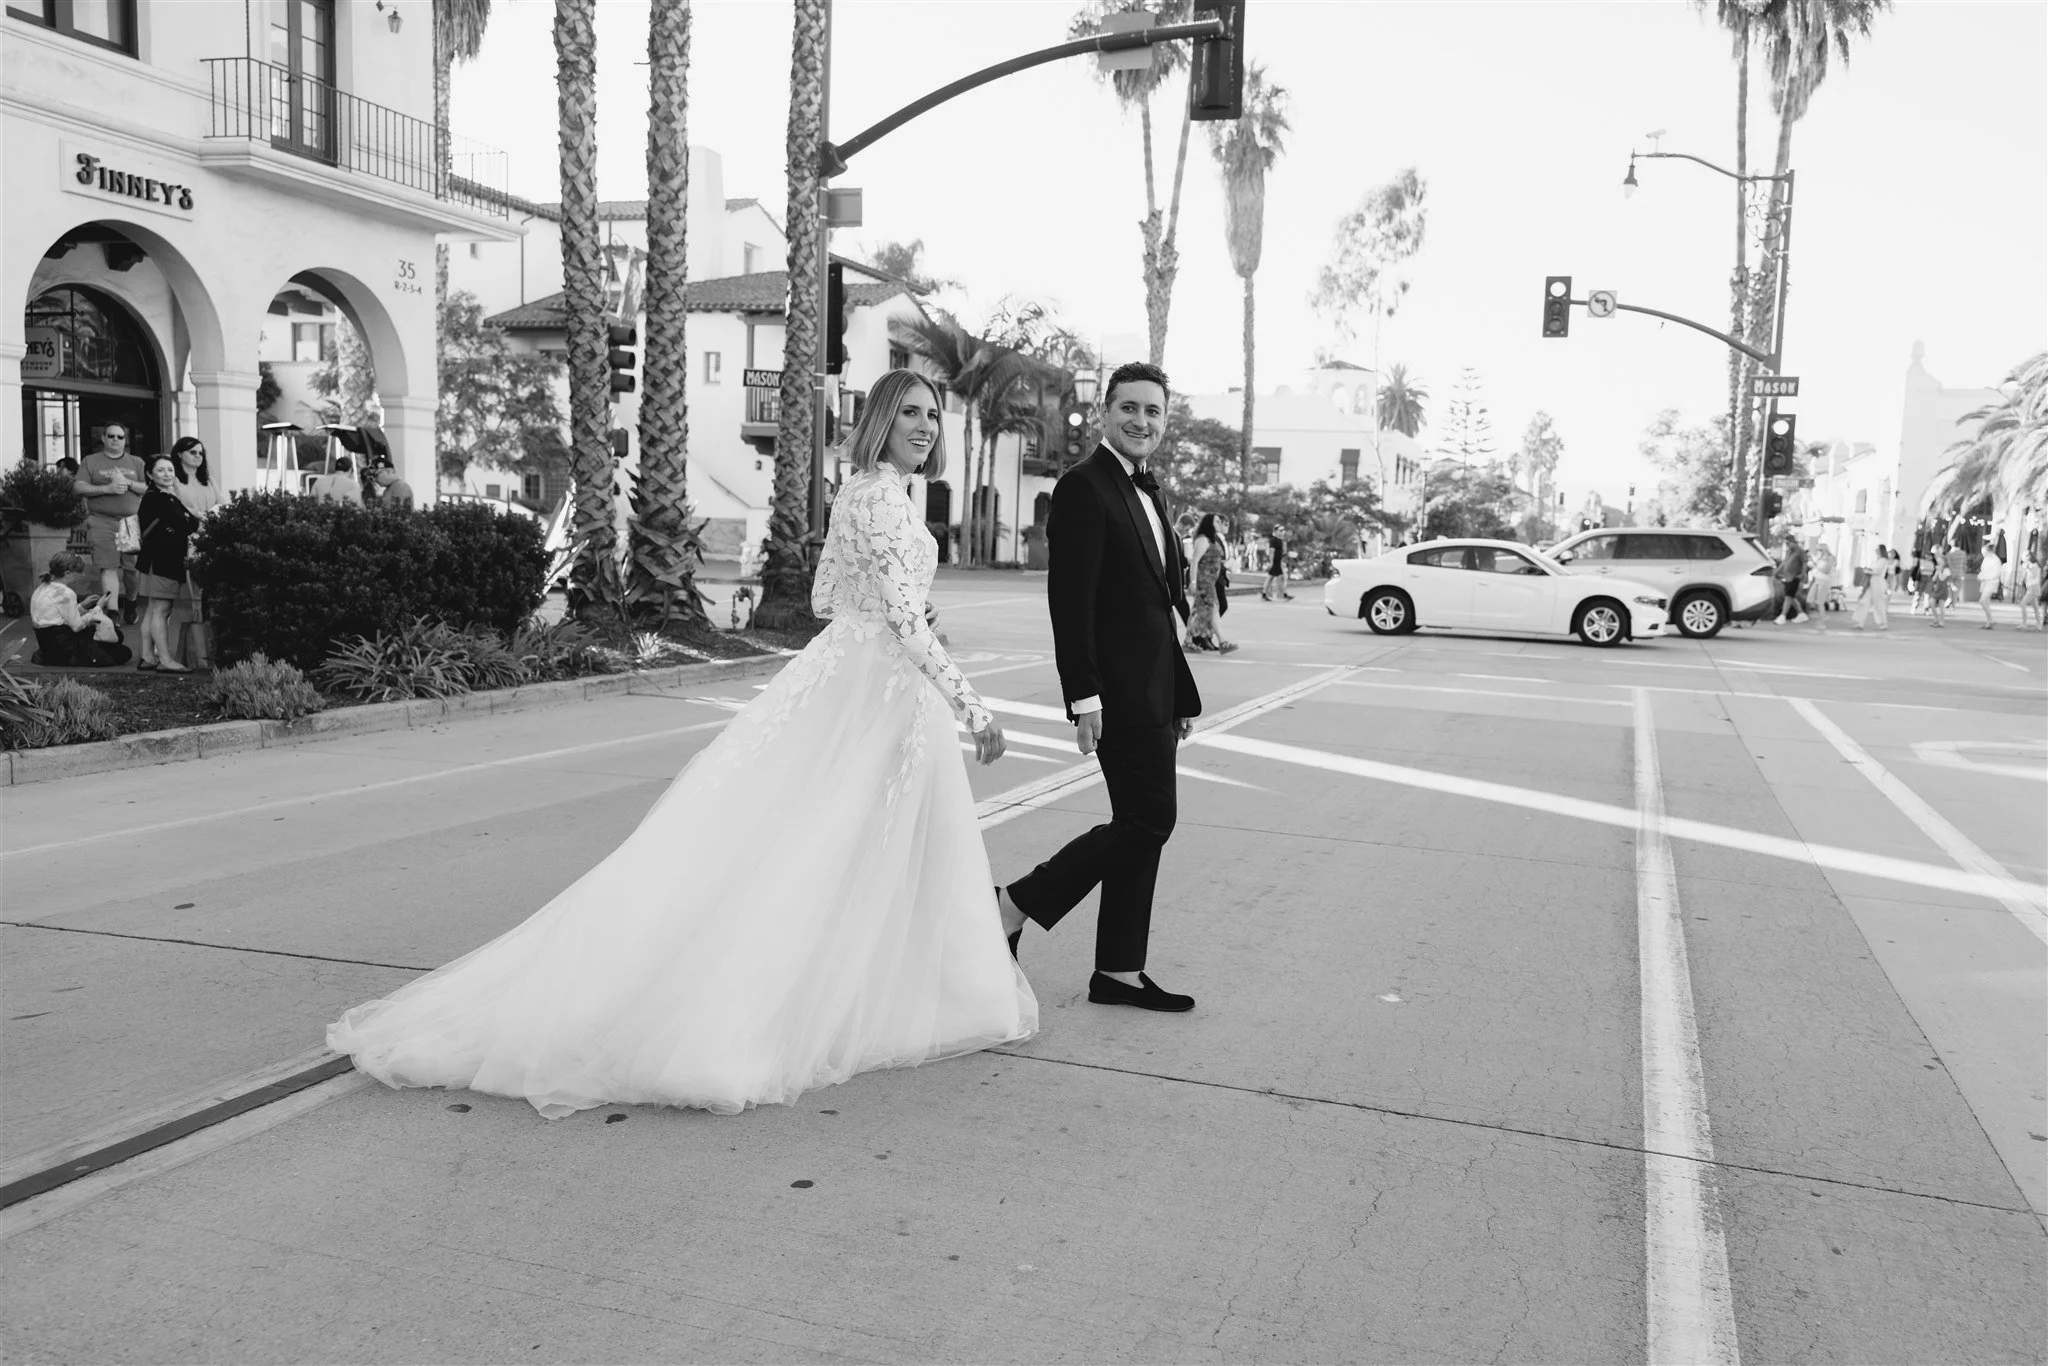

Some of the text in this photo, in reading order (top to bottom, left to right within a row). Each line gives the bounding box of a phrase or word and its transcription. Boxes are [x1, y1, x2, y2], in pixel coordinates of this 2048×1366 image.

[76, 152, 194, 210] FINNEY'S
[398, 259, 416, 280] 35
[25, 337, 55, 358] NEY'S
[745, 370, 780, 387] MASON
[1753, 379, 1797, 395] MASON
